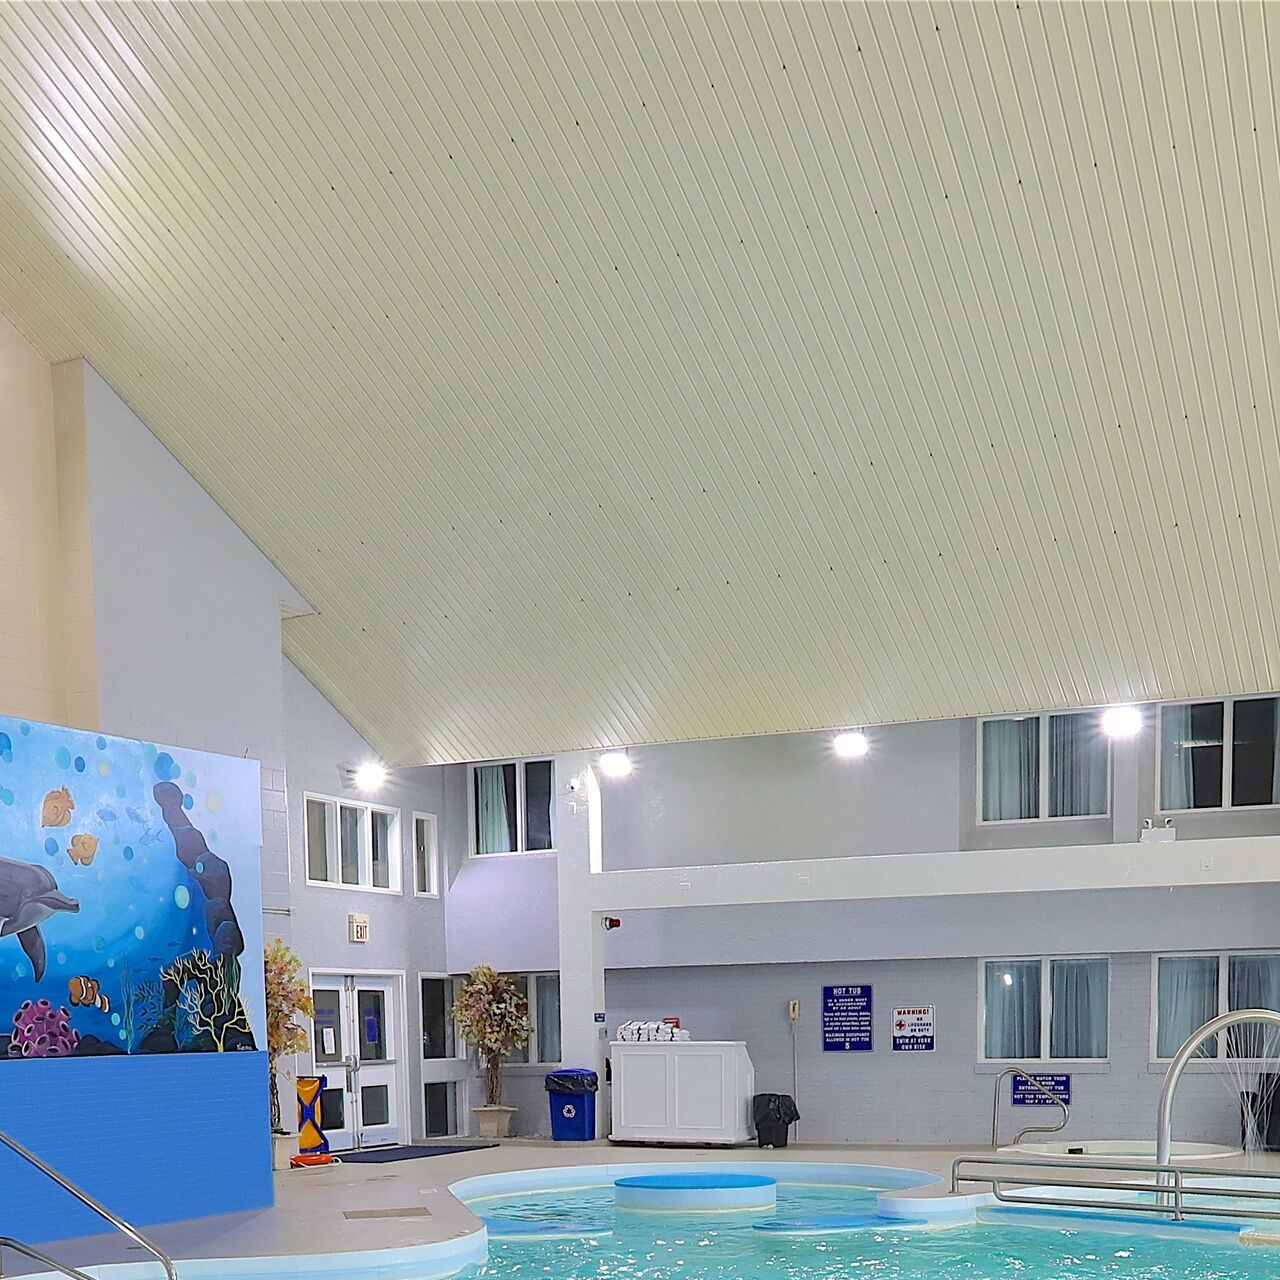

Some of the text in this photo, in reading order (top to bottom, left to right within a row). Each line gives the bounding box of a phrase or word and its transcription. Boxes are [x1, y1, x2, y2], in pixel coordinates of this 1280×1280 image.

[356, 925, 368, 939] EXIT
[833, 987, 862, 995] HOT TUB
[845, 1042, 850, 1050] 5
